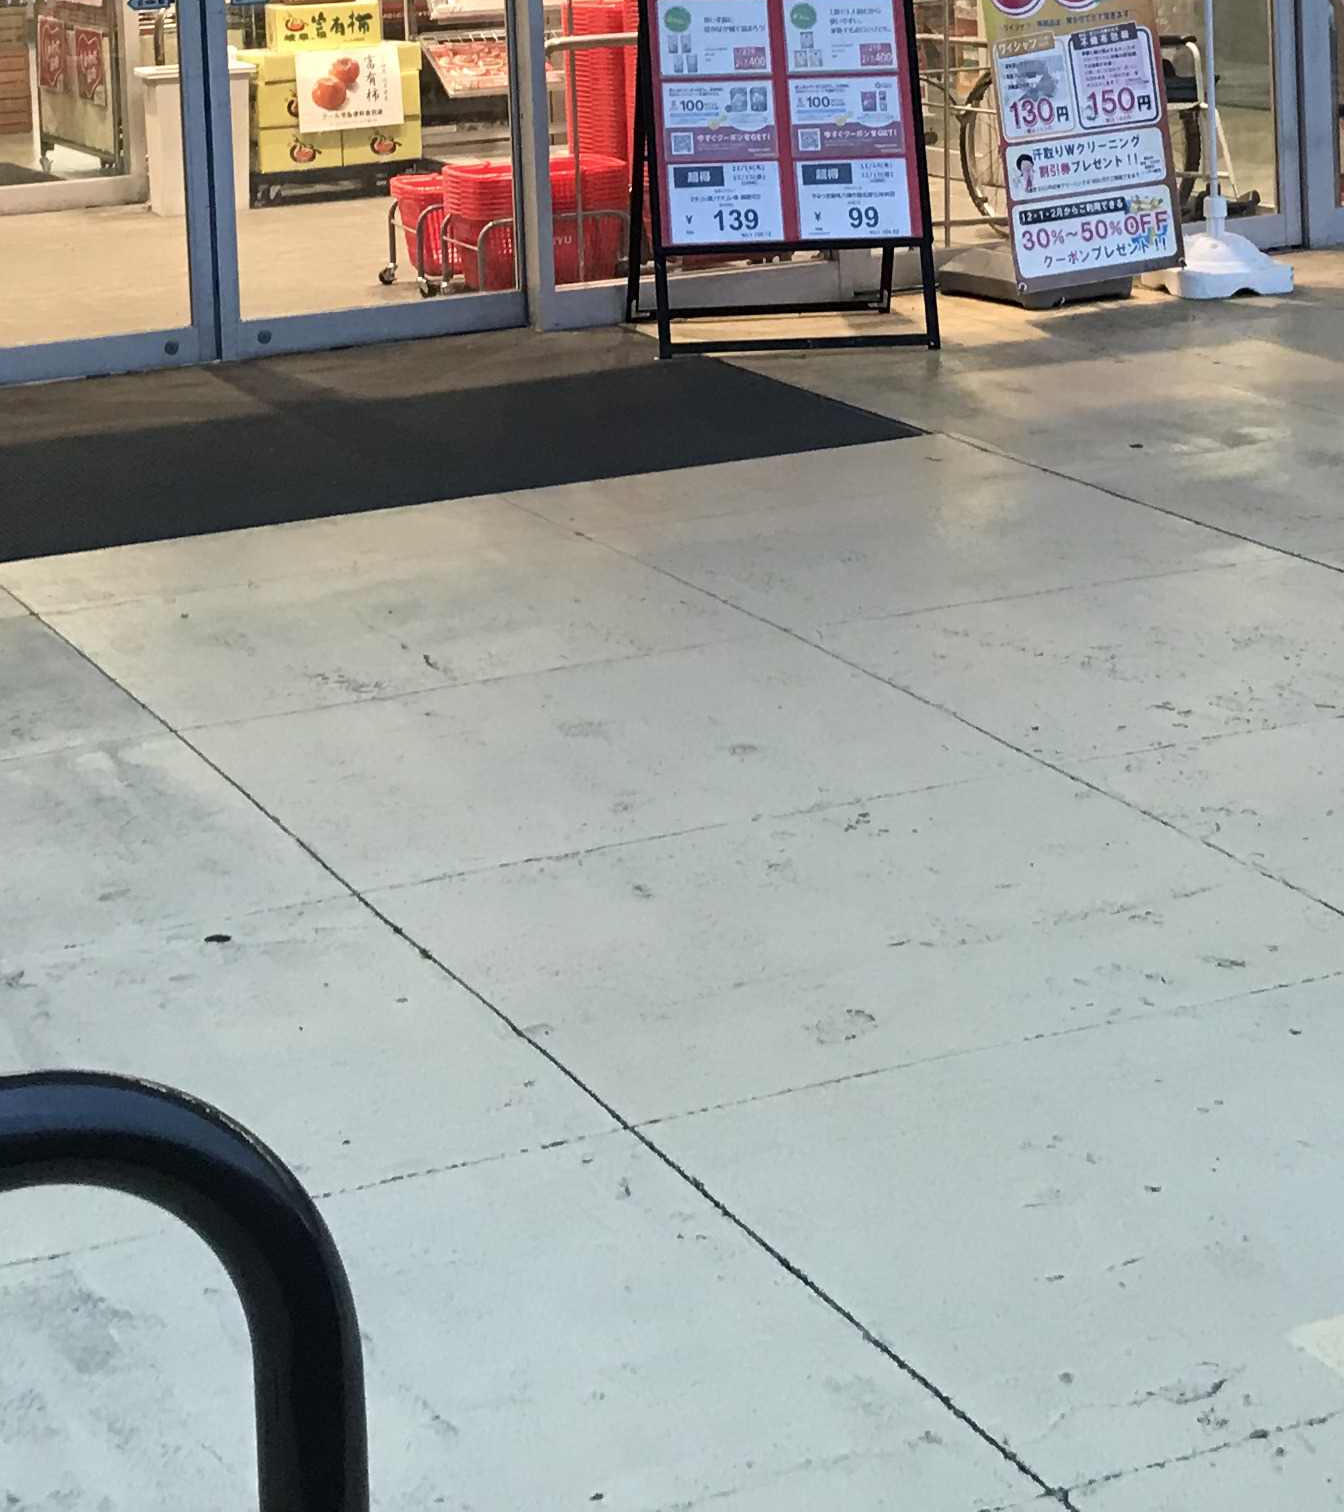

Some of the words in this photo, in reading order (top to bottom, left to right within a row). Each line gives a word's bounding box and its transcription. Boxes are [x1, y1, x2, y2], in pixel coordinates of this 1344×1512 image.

[680, 100, 704, 112] 100
[807, 96, 830, 108] 100
[1009, 97, 1069, 129] 130円
[1086, 86, 1152, 119] 150円
[1032, 134, 1140, 161] 汗取りWクリーニング
[713, 208, 759, 232] 139
[848, 206, 880, 229] 99
